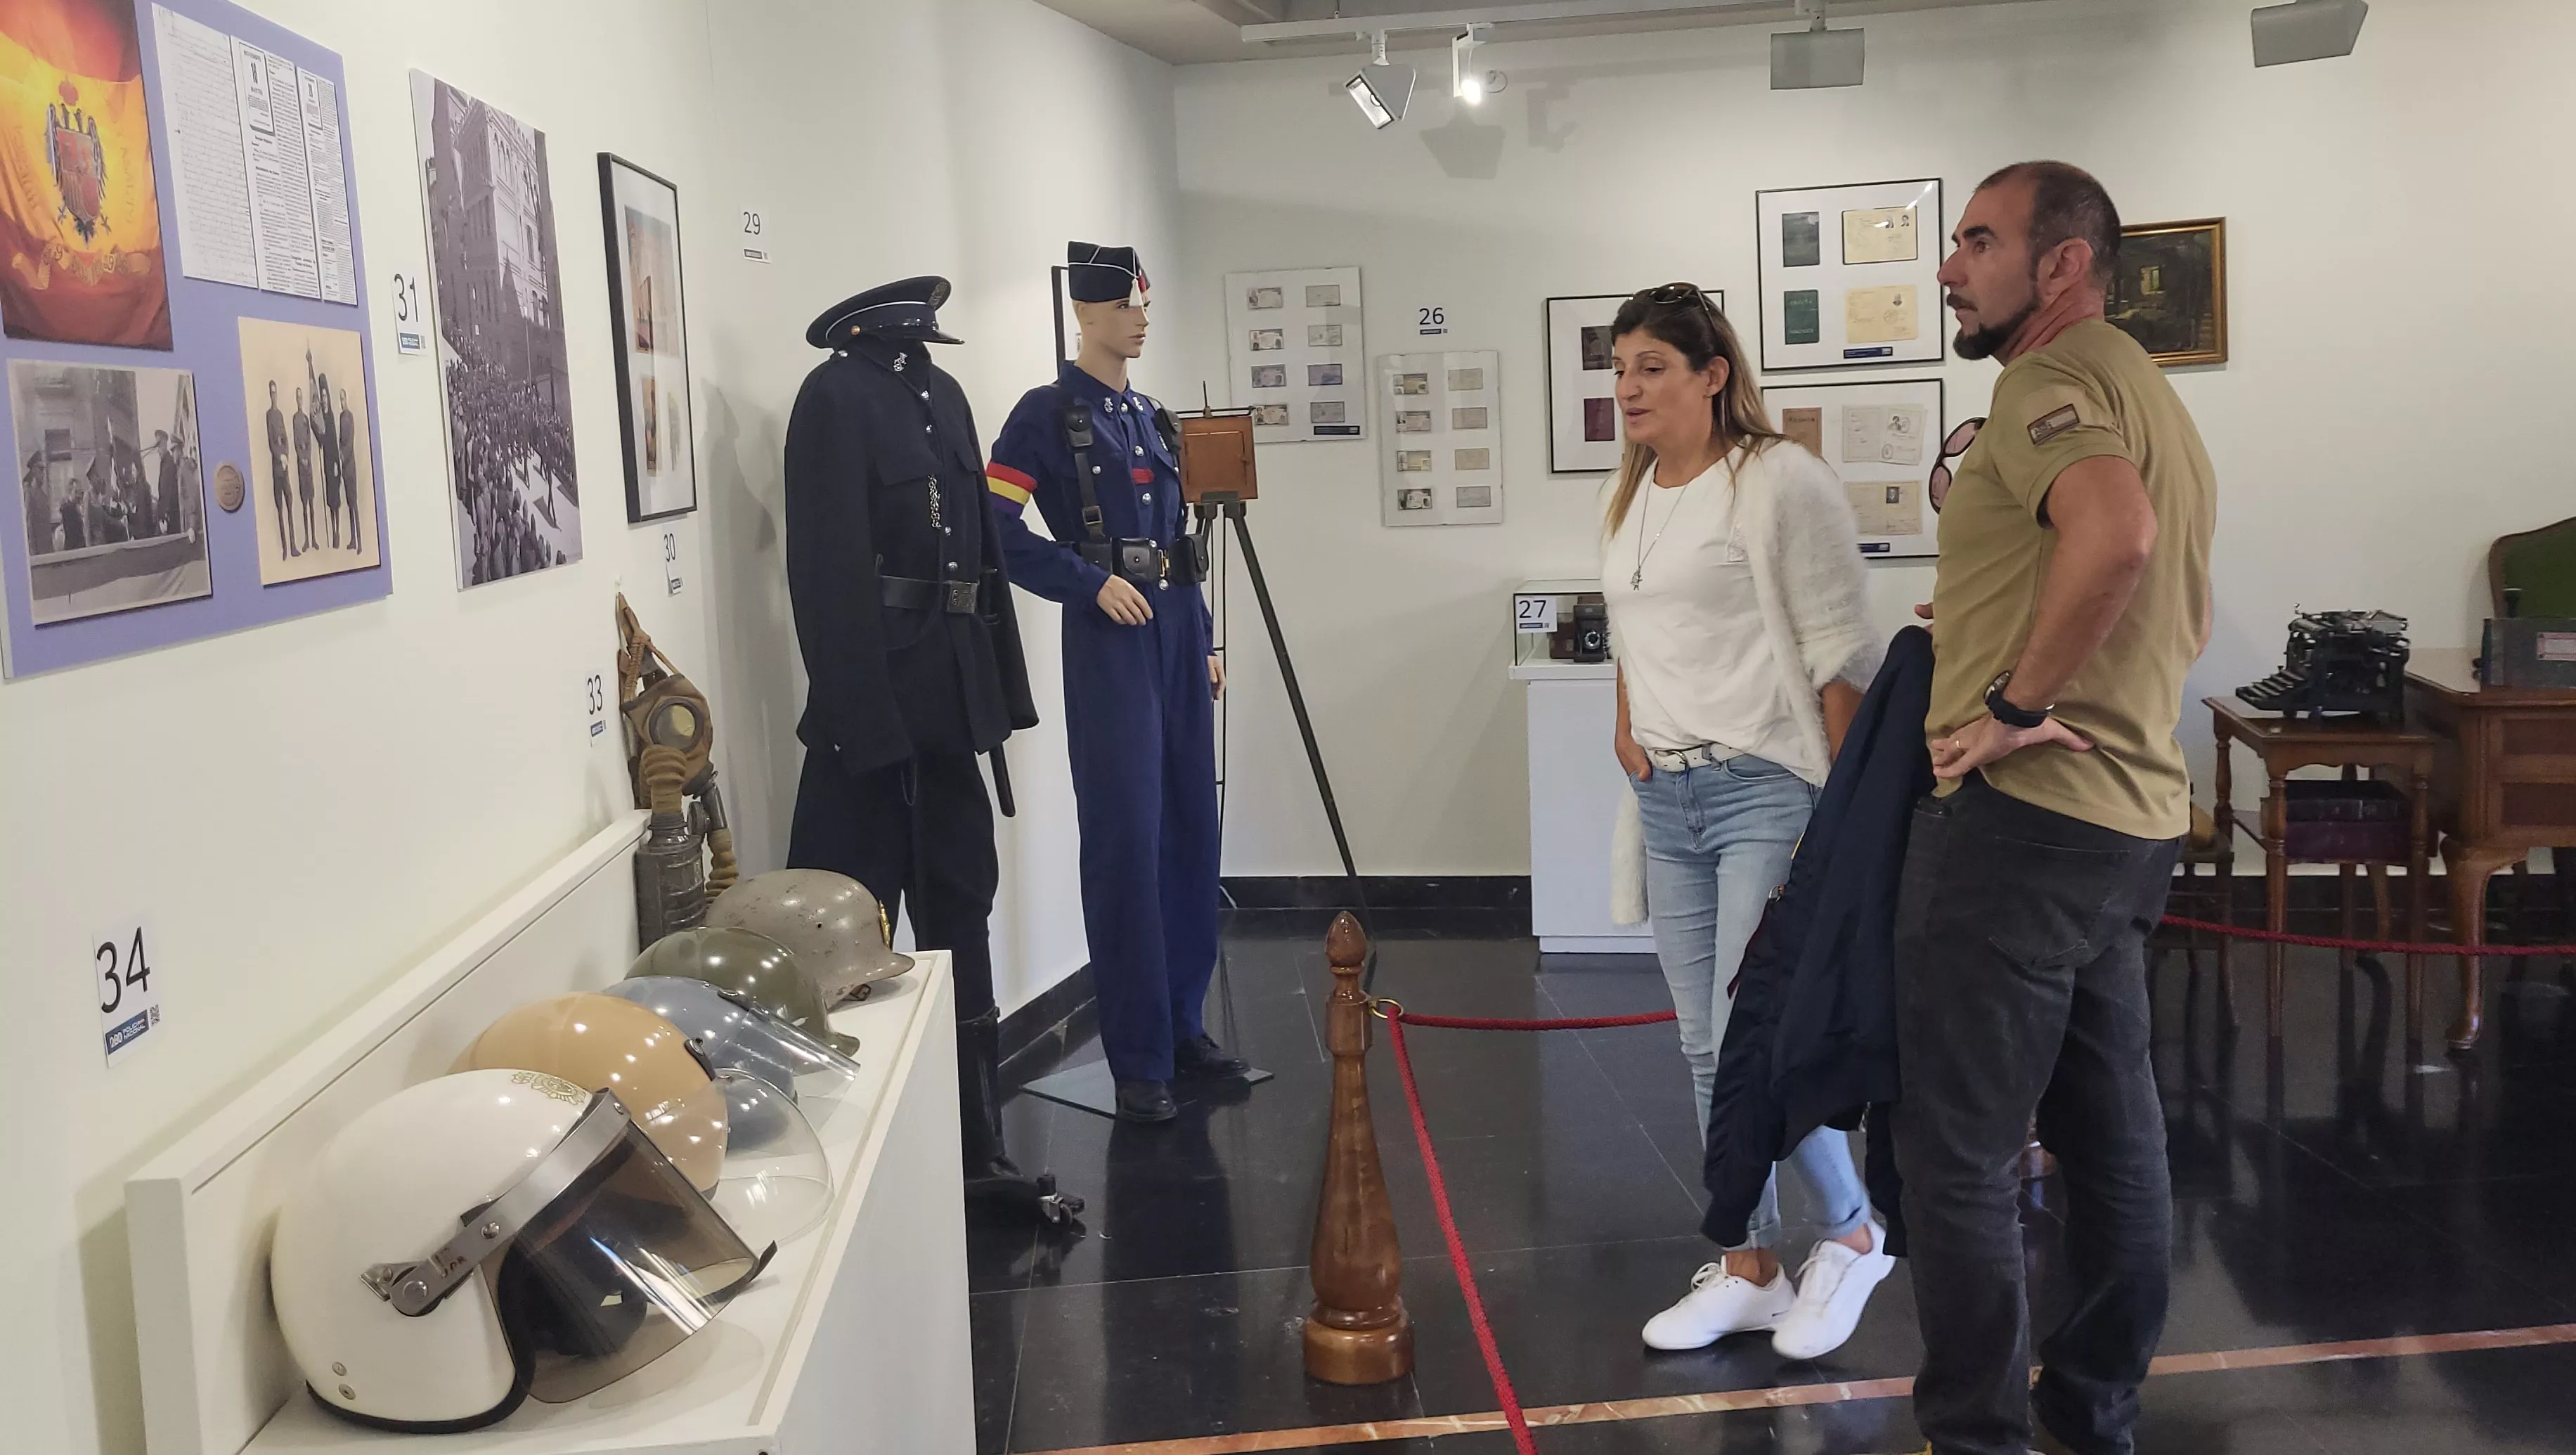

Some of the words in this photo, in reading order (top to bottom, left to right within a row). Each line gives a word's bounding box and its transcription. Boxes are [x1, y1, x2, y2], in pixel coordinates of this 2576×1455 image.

[744, 212, 760, 235] 29
[394, 273, 418, 322] 31
[1419, 307, 1444, 325] 26
[664, 533, 675, 562] 30
[1519, 600, 1546, 618] 27
[588, 674, 603, 715] 33
[96, 926, 150, 1014] 34
